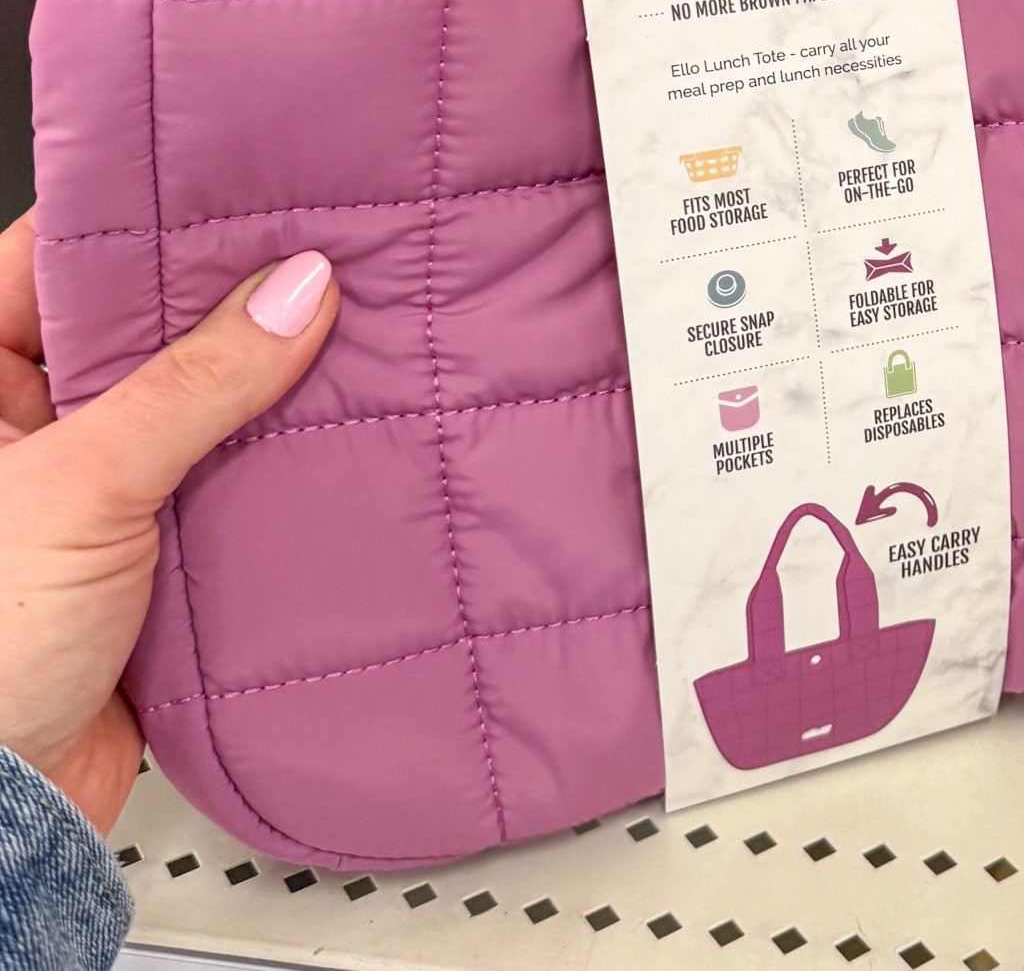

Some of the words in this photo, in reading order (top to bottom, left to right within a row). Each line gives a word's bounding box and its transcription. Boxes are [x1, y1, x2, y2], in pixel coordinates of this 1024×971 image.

[671, 2, 691, 22] NO
[671, 62, 700, 78] Ello
[704, 55, 751, 74] Lunch
[752, 50, 786, 67] Tote
[800, 42, 836, 59] carry
[839, 38, 858, 52] all
[860, 34, 891, 54] your
[668, 84, 707, 101] meal
[709, 78, 745, 98] prep
[748, 73, 777, 90] and
[780, 66, 821, 84] lunch
[824, 54, 902, 76] necessities
[837, 163, 889, 187] PERFECT
[892, 159, 917, 177] FOR
[683, 195, 711, 216] FITS
[714, 188, 750, 210] MOST
[844, 177, 915, 204] ON-THE-GO
[670, 215, 706, 236] FOOD
[709, 203, 768, 229] STORAGE
[848, 284, 908, 311] FOLDABLE
[911, 279, 936, 297] FOR
[850, 307, 882, 328] EASY
[884, 296, 939, 322] STORAGE
[687, 318, 738, 344] SECURE
[740, 311, 775, 332] SNAP
[704, 330, 763, 357] CLOSURE
[873, 399, 934, 425] REPLACES
[864, 413, 945, 443] DISPOSABLES
[713, 432, 775, 460] MULTIPLE
[716, 449, 774, 475] POCKETS
[888, 538, 926, 563] EASY
[931, 526, 982, 552] CARRY
[901, 548, 970, 579] HANDLES
